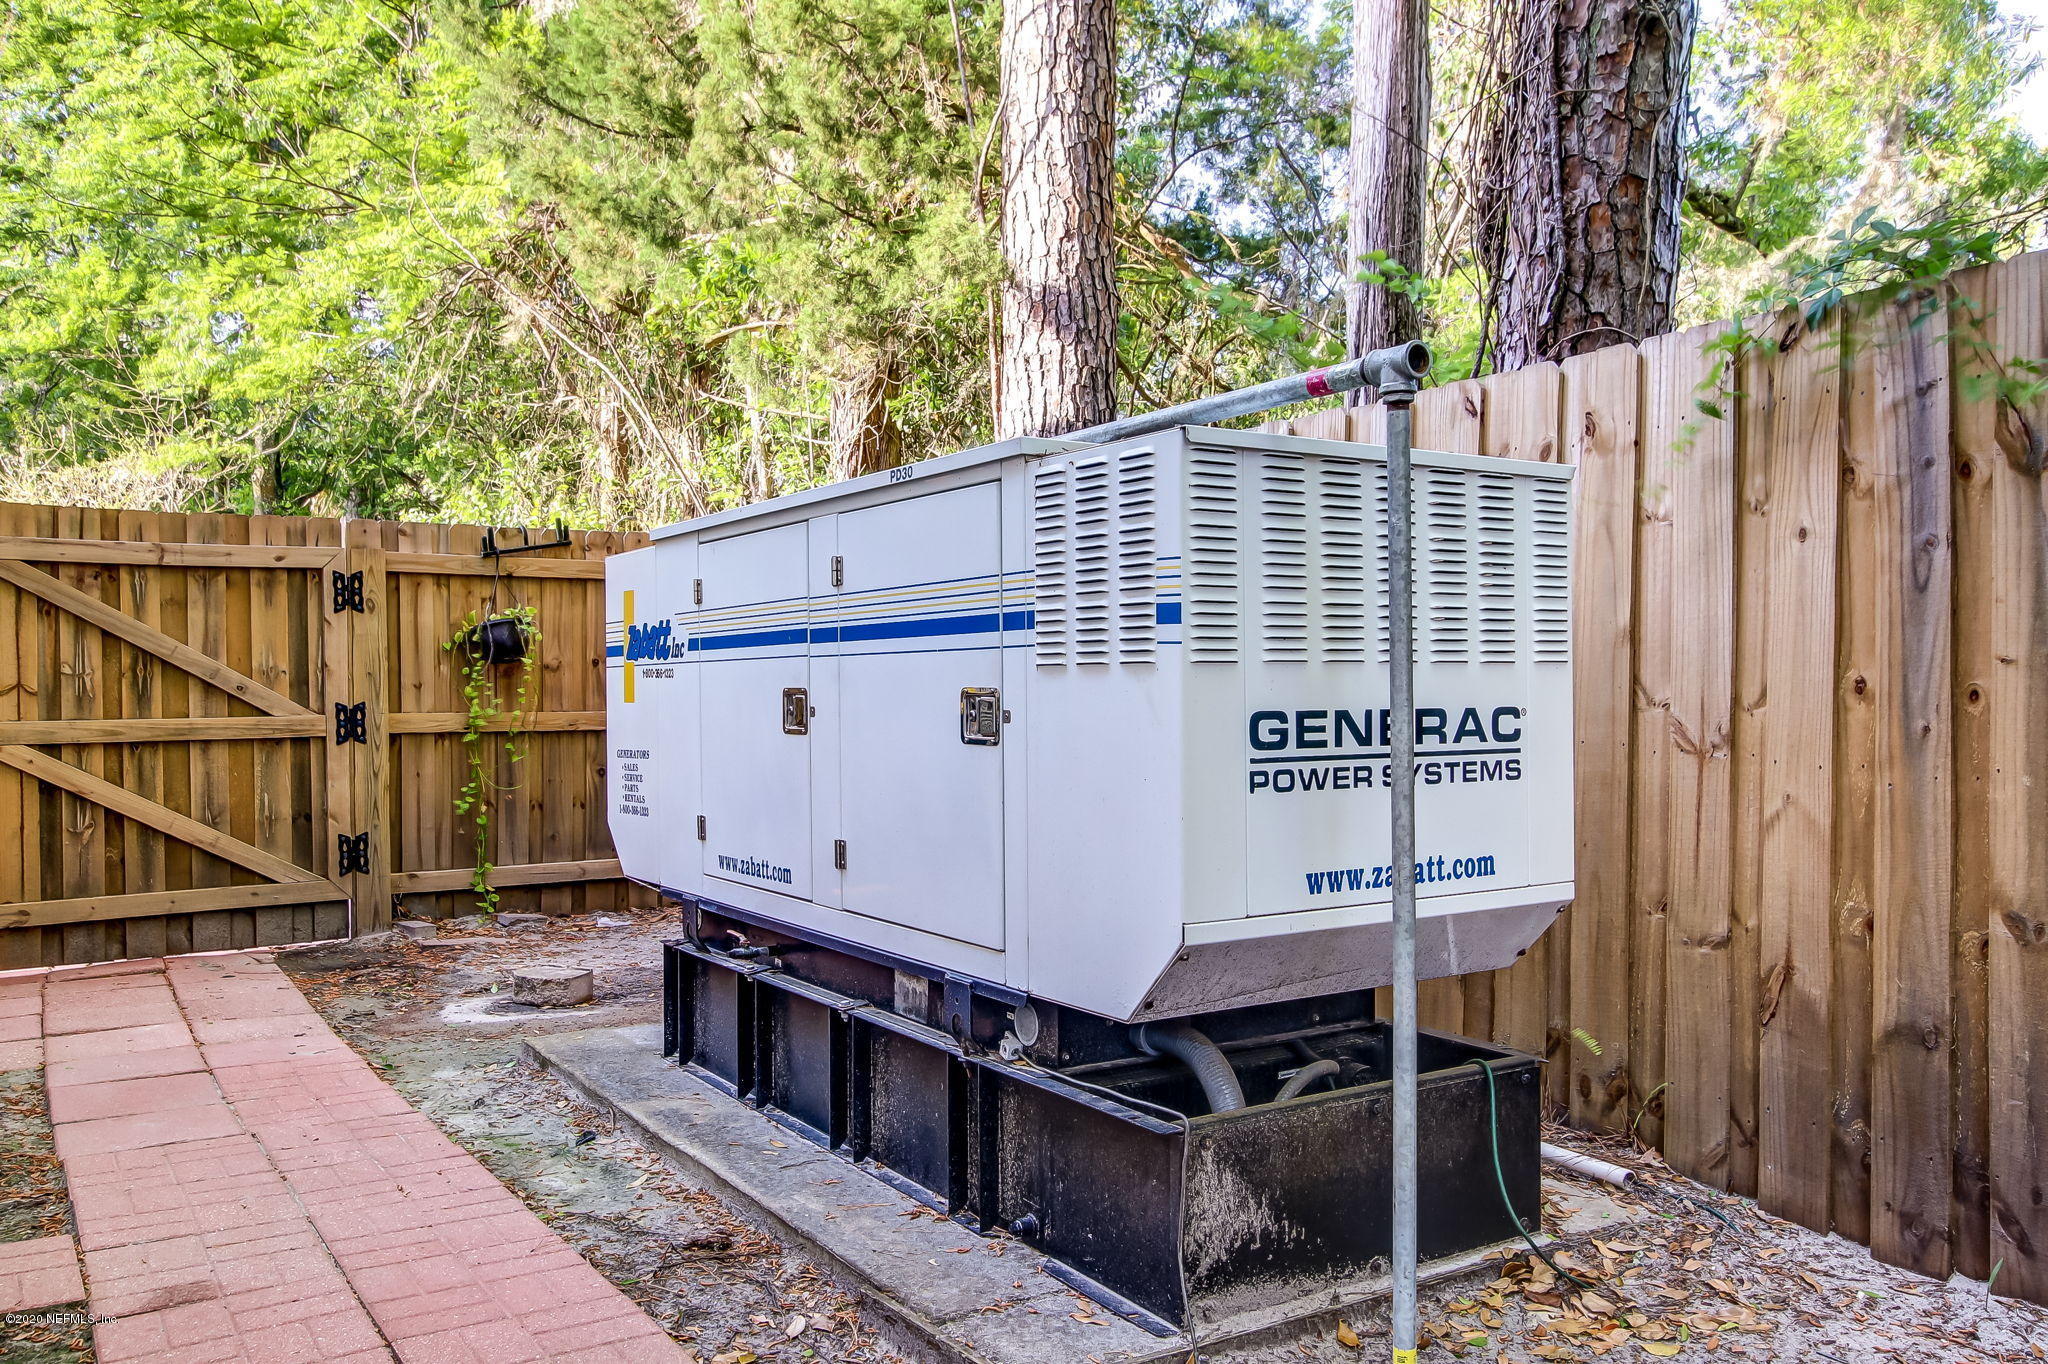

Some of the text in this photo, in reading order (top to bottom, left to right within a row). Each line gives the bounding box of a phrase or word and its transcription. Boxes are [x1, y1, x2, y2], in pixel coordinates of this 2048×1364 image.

[890, 466, 913, 483] PD30
[671, 637, 685, 659] Inc
[616, 749, 650, 760] GENERATORS
[1250, 766, 1373, 794] POWER
[718, 855, 792, 884] www.zabatt.com
[1305, 855, 1496, 895] www.zaatt.com
